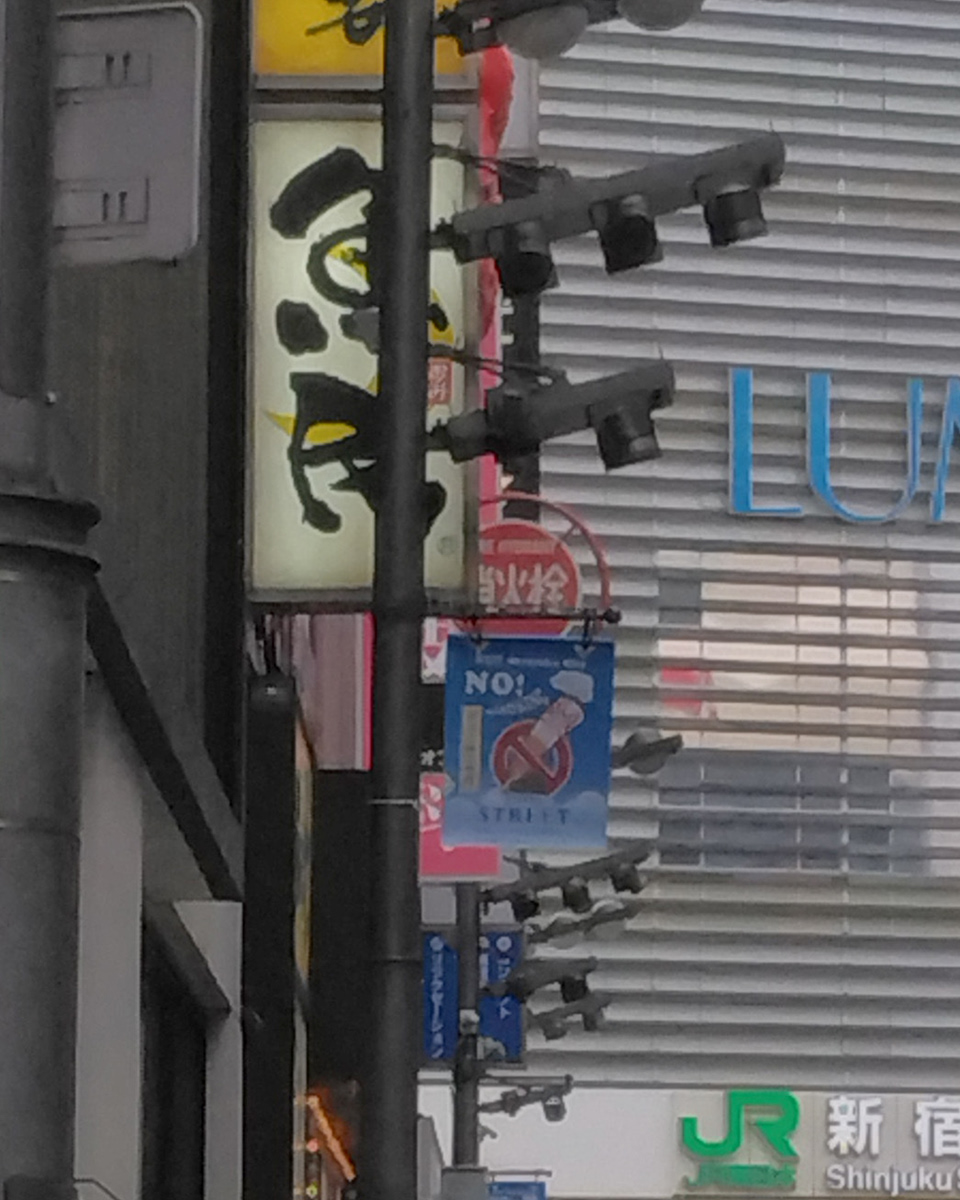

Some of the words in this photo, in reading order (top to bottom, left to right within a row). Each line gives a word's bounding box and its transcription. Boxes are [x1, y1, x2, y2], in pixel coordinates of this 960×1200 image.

[465, 670, 526, 697] NO!
[679, 1090, 800, 1157] JR
[825, 1164, 953, 1197] Shinjuku
